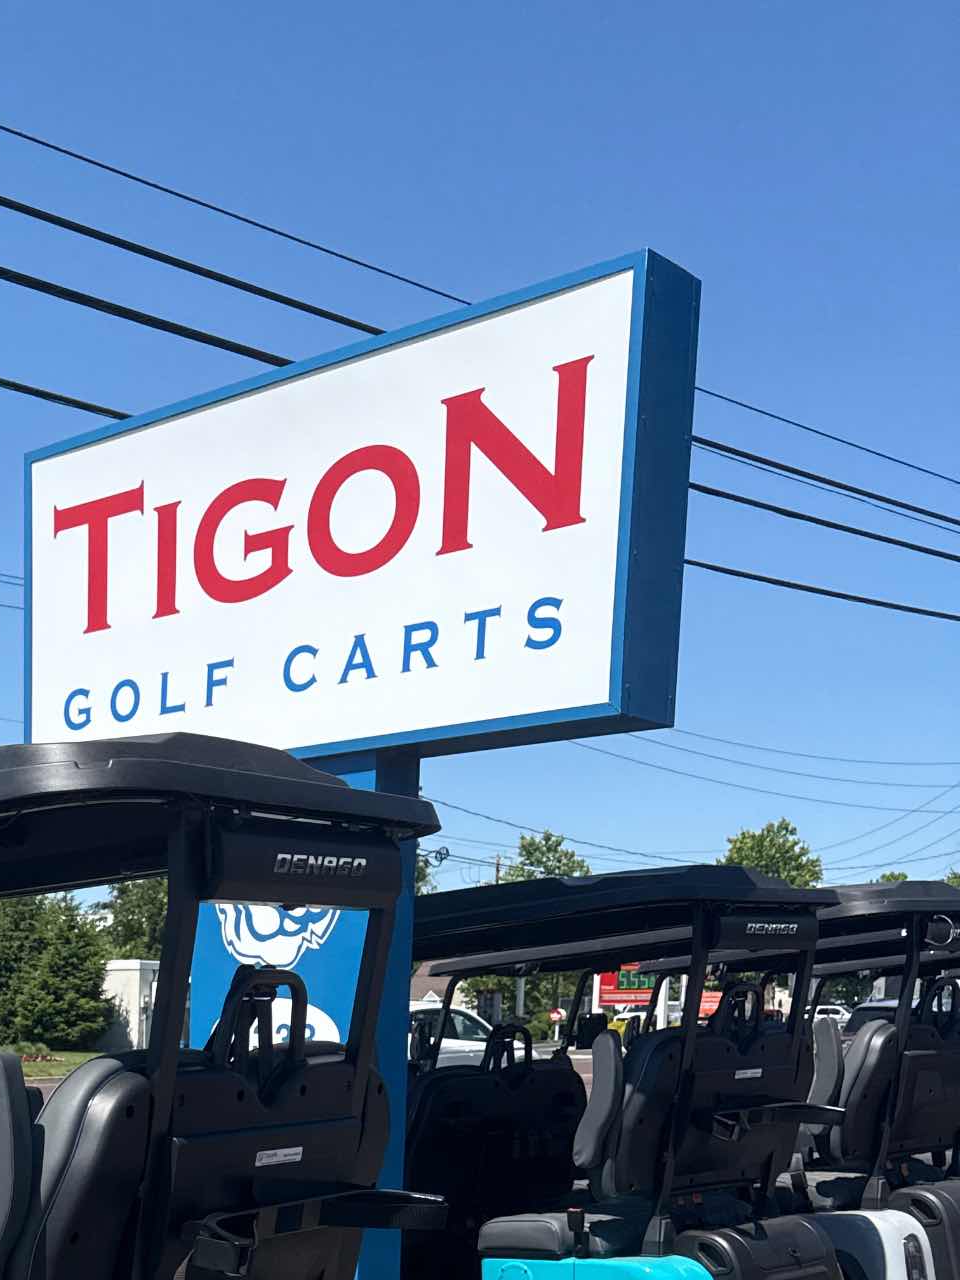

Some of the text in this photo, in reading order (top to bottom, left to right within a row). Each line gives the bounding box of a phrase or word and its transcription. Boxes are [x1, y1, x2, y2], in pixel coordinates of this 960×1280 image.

[54, 355, 595, 634] TIGON
[63, 596, 565, 732] GOLF CARTS
[273, 853, 367, 876] DENAGO
